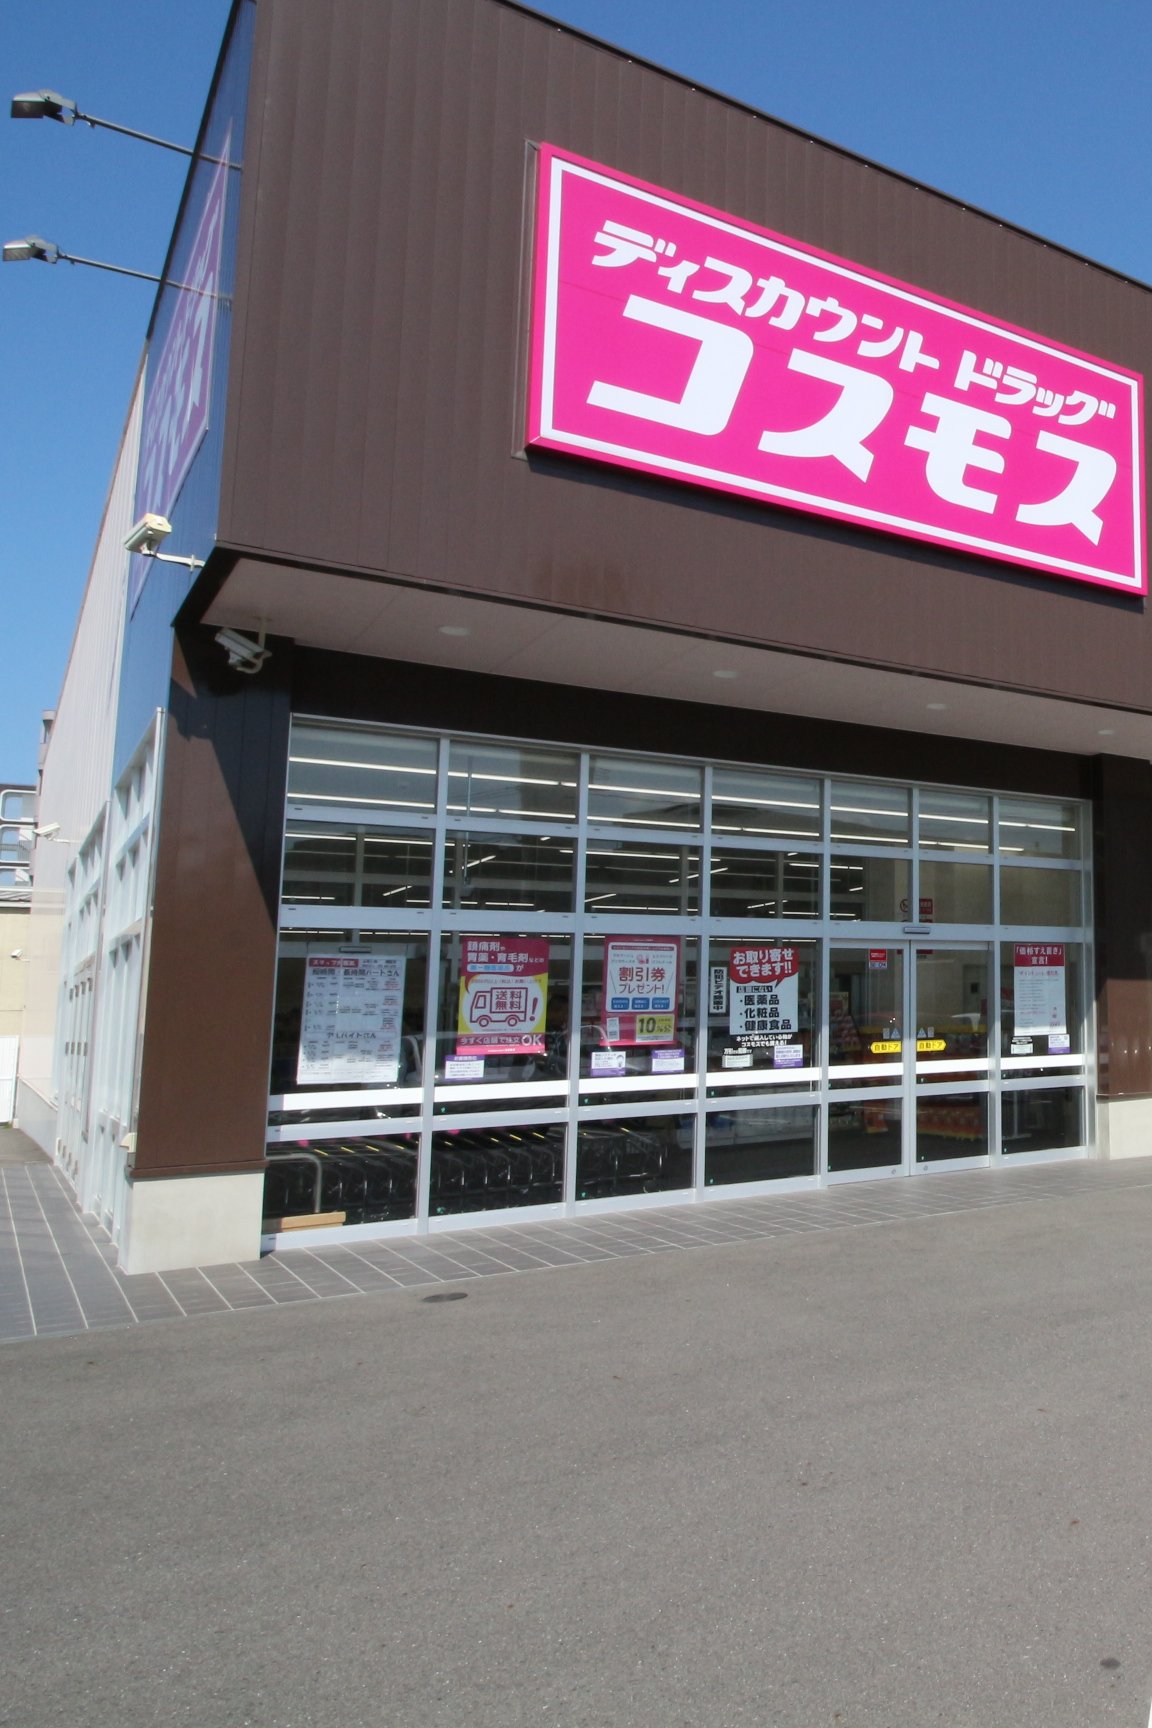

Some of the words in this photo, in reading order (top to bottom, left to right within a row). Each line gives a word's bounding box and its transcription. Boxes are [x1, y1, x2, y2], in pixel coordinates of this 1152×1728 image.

[591, 220, 939, 373] ディスカウント
[954, 349, 1116, 425] ドラッグ
[586, 293, 1117, 546] コスモス
[733, 948, 795, 965] お取り寄せ
[618, 966, 666, 982] 割引券
[736, 961, 793, 977] できます!!
[495, 990, 522, 1000] 送料
[495, 1000, 521, 1011] 無料
[874, 1043, 899, 1052] 自動ドア
[919, 1041, 943, 1050] 自動ドア
